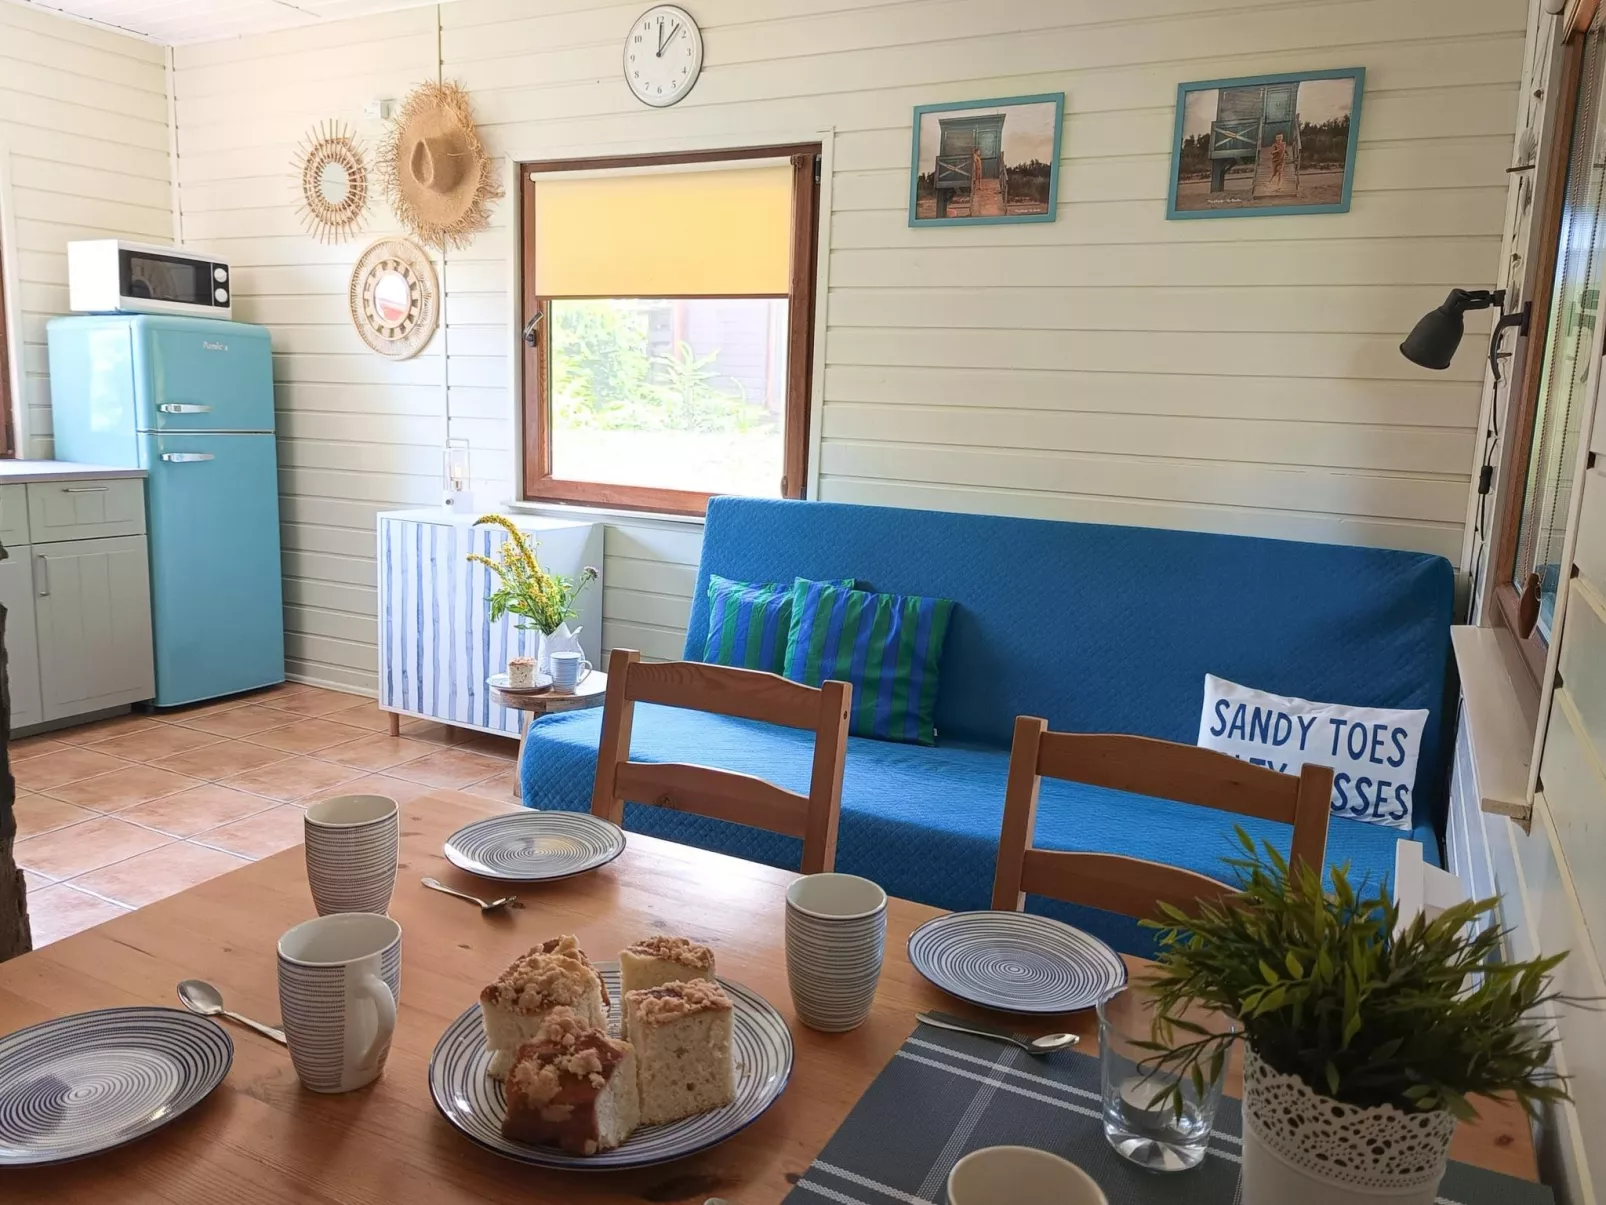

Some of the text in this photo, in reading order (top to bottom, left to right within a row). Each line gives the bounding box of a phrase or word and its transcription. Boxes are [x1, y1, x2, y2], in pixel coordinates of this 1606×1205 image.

[1210, 698, 1317, 751] SANDY
[1329, 718, 1408, 768] TOES
[1330, 772, 1409, 821] SSES
